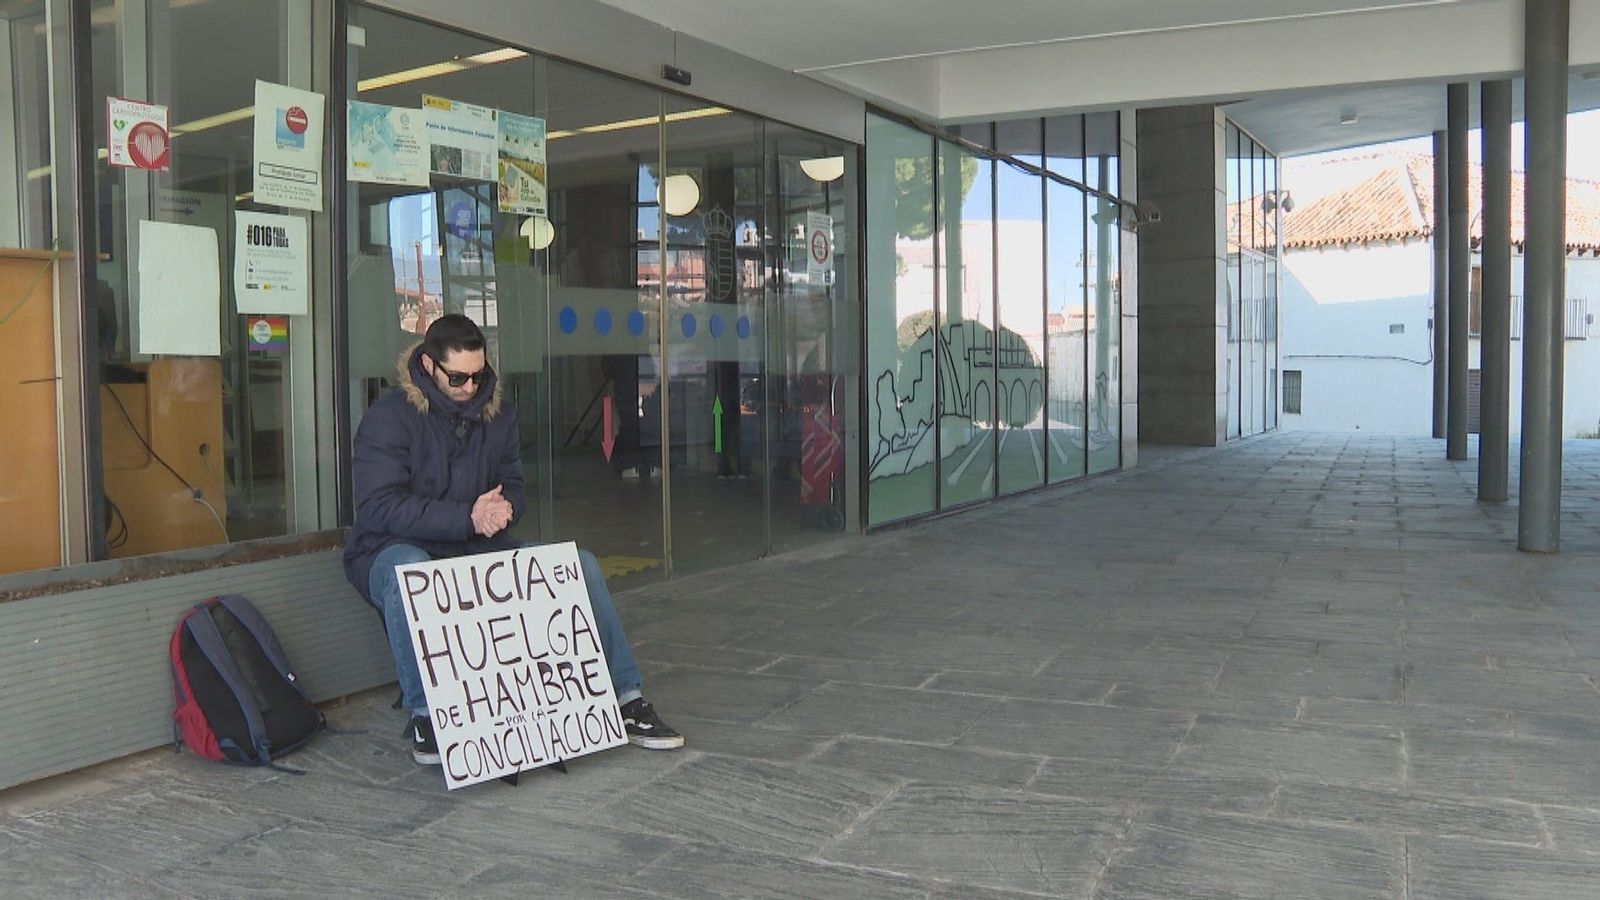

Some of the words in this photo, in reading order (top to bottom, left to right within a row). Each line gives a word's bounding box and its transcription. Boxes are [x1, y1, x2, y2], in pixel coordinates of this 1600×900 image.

[520, 177, 529, 188] Tu
[247, 224, 272, 246] #016
[273, 226, 286, 237] PARA
[403, 550, 556, 622] POLICÍA
[554, 561, 579, 585] EN
[418, 604, 601, 688] HUELGA
[436, 704, 463, 730] DE
[463, 658, 607, 723] HAMBRE
[446, 704, 623, 782] CONCILIACIÓN
